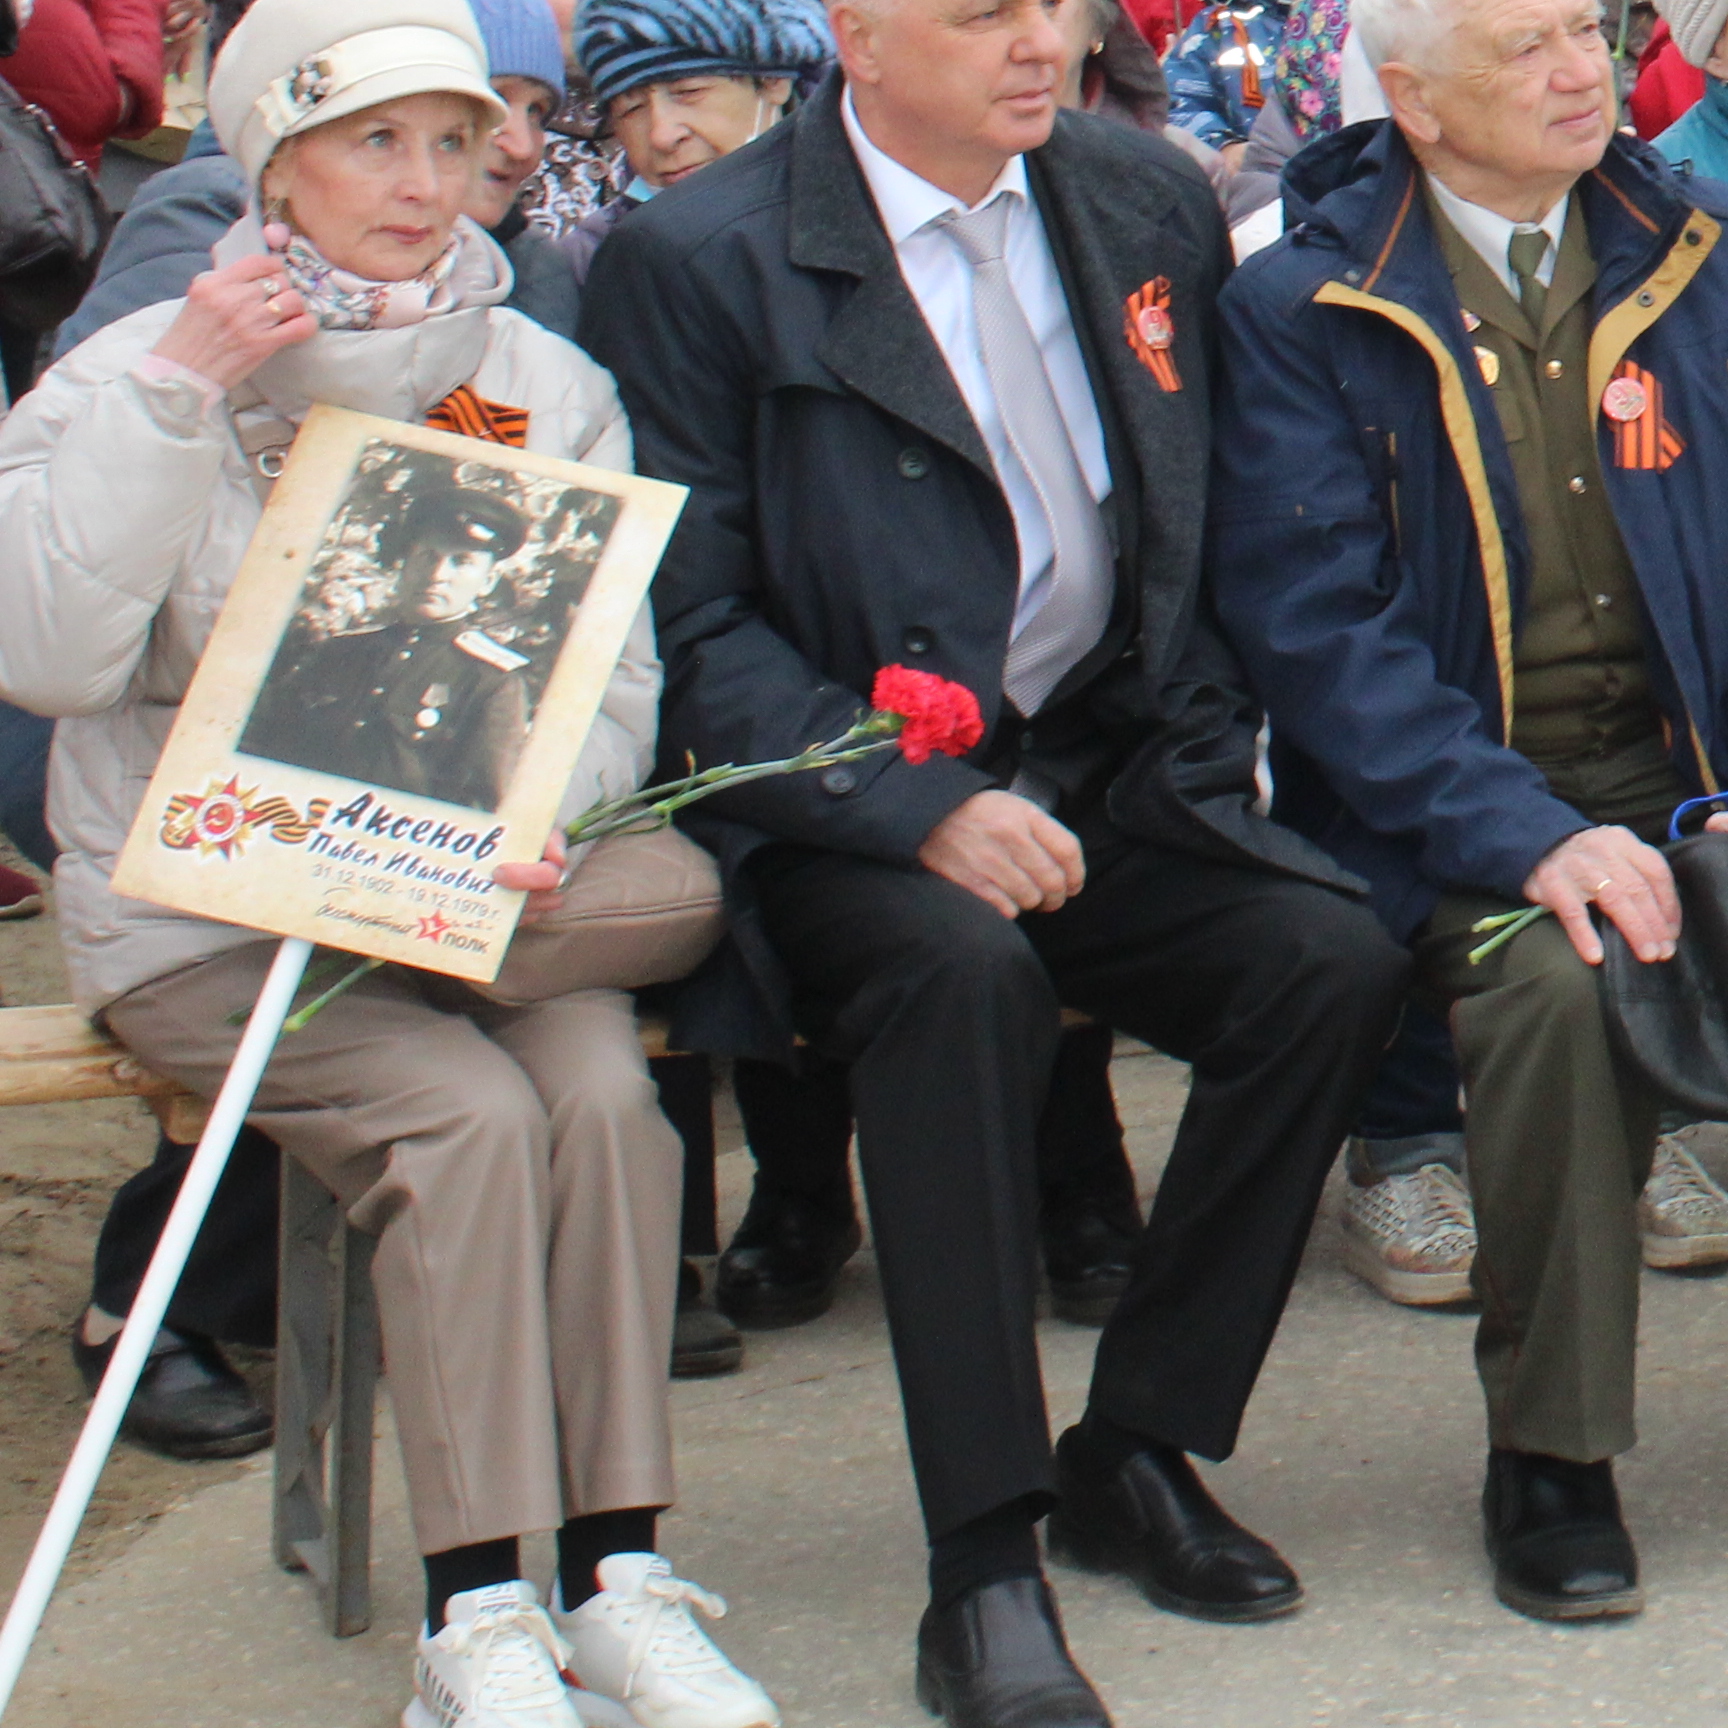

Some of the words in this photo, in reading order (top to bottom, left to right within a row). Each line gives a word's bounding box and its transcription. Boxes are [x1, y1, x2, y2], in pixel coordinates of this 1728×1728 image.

[331, 791, 505, 861] Аксенов
[308, 832, 380, 867] Павел
[383, 852, 496, 894] Иванович
